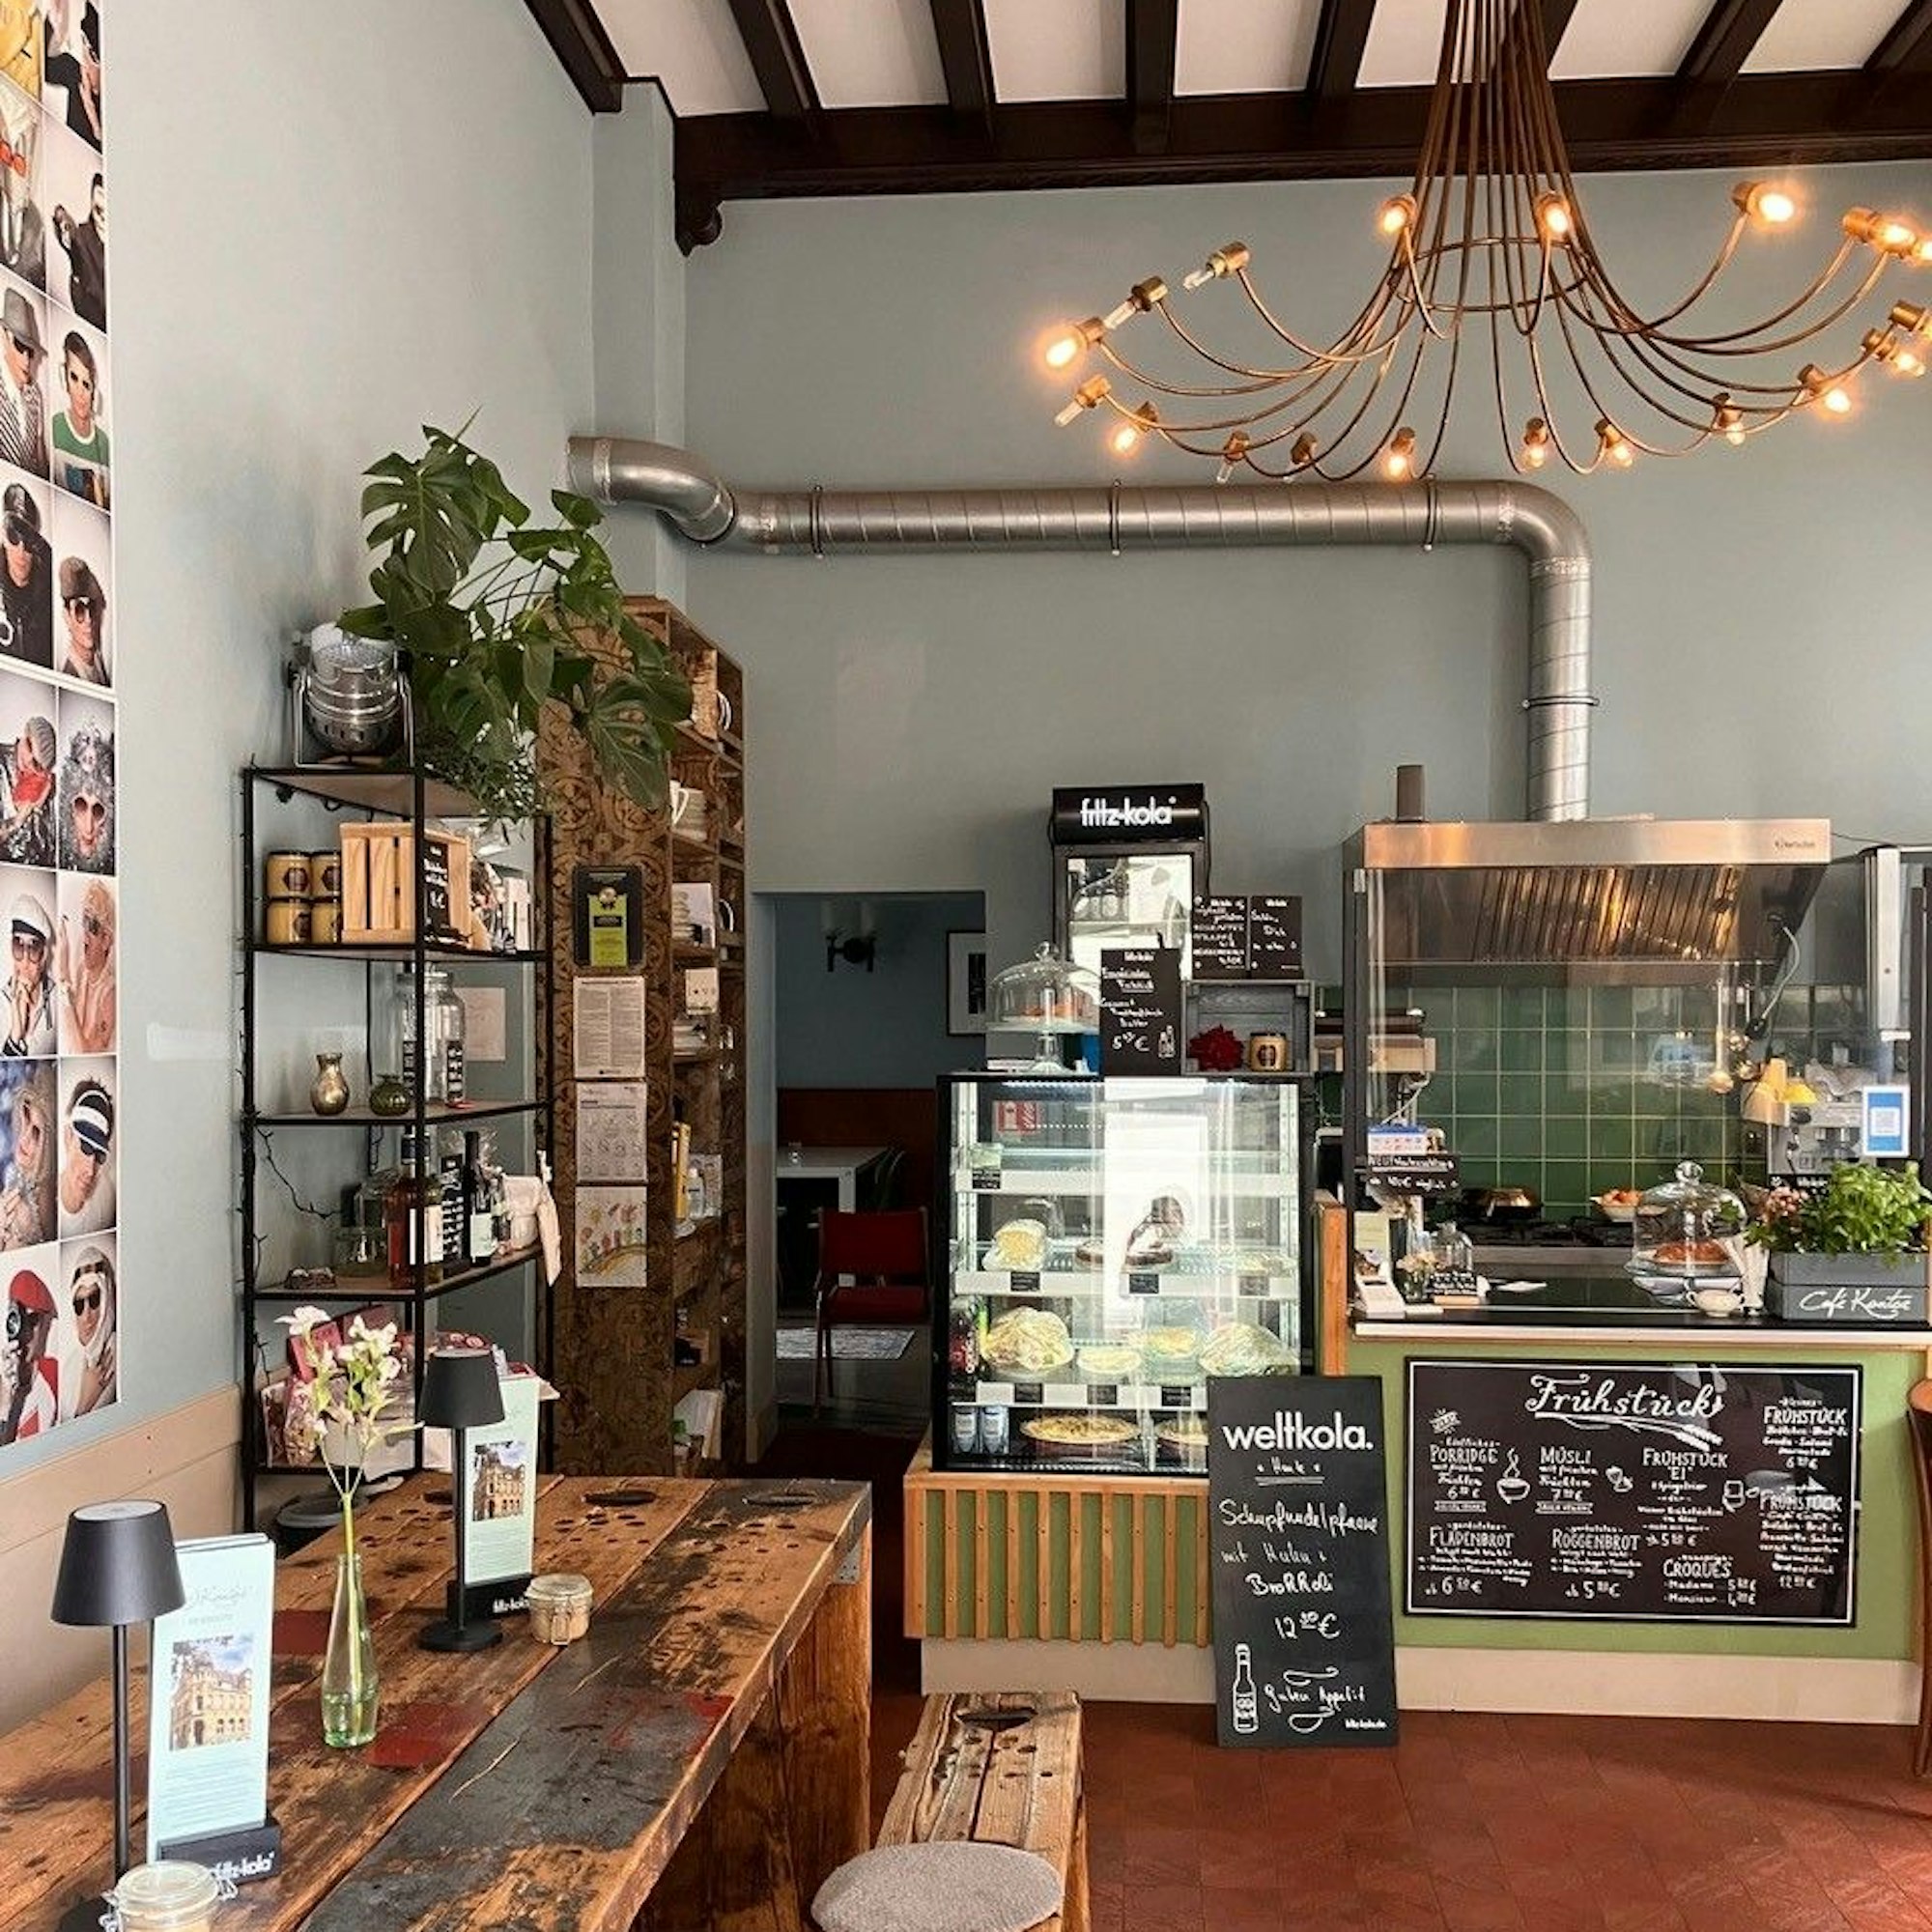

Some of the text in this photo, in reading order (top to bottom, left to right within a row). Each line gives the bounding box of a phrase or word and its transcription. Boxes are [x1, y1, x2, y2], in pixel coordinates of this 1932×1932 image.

[1080, 796, 1173, 826] fritz-kola
[1799, 1287, 1847, 1319] Café
[1524, 1373, 1725, 1419] Frühstück
[1430, 1443, 1499, 1464] PORRIDGE
[1540, 1445, 1592, 1464] MÜSLI
[1642, 1447, 1728, 1468] FRÜHSTÜCK
[1430, 1525, 1516, 1548] FLADENBROT
[1552, 1528, 1641, 1551] ROGGENBROT
[1662, 1558, 1733, 1578] CROQUES
